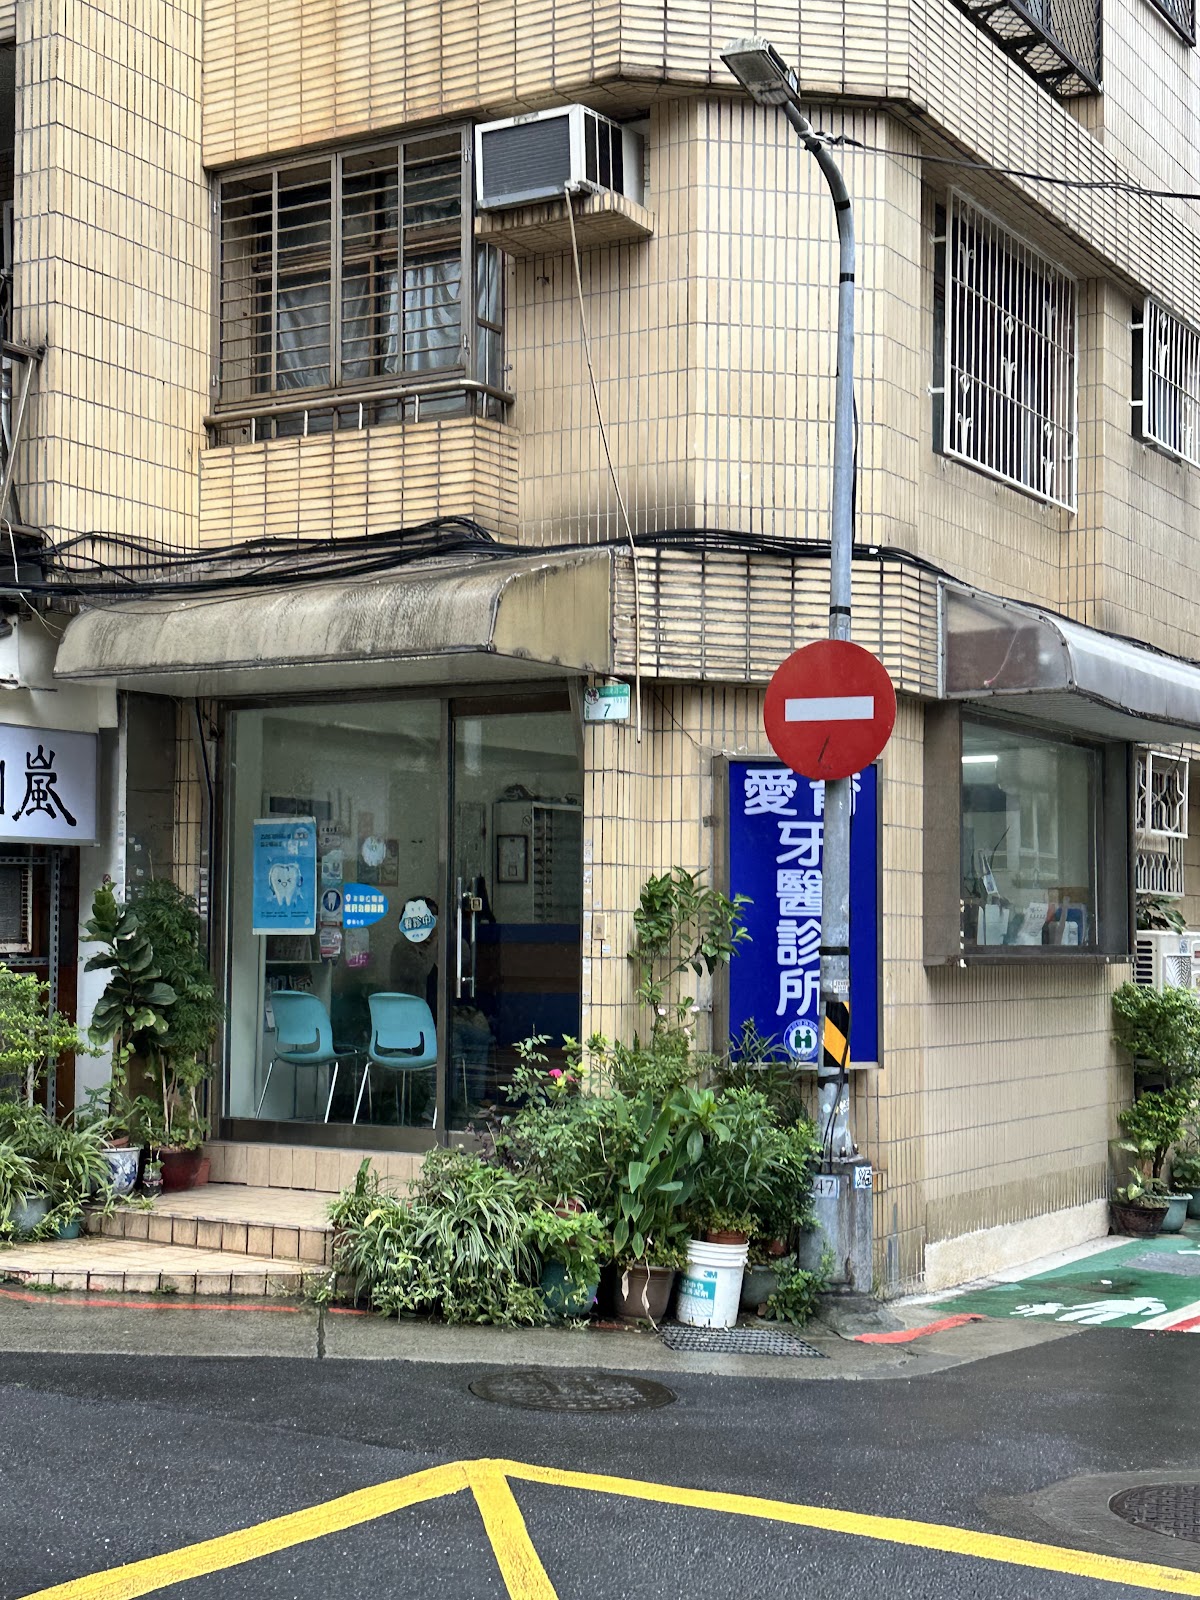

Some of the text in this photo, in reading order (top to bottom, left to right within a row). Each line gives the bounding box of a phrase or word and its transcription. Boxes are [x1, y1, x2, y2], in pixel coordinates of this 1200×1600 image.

[604, 703, 611, 718] 7
[0, 745, 77, 827] 嵐
[776, 821, 825, 1016] 牙醫診所
[703, 1270, 718, 1279] 3M
